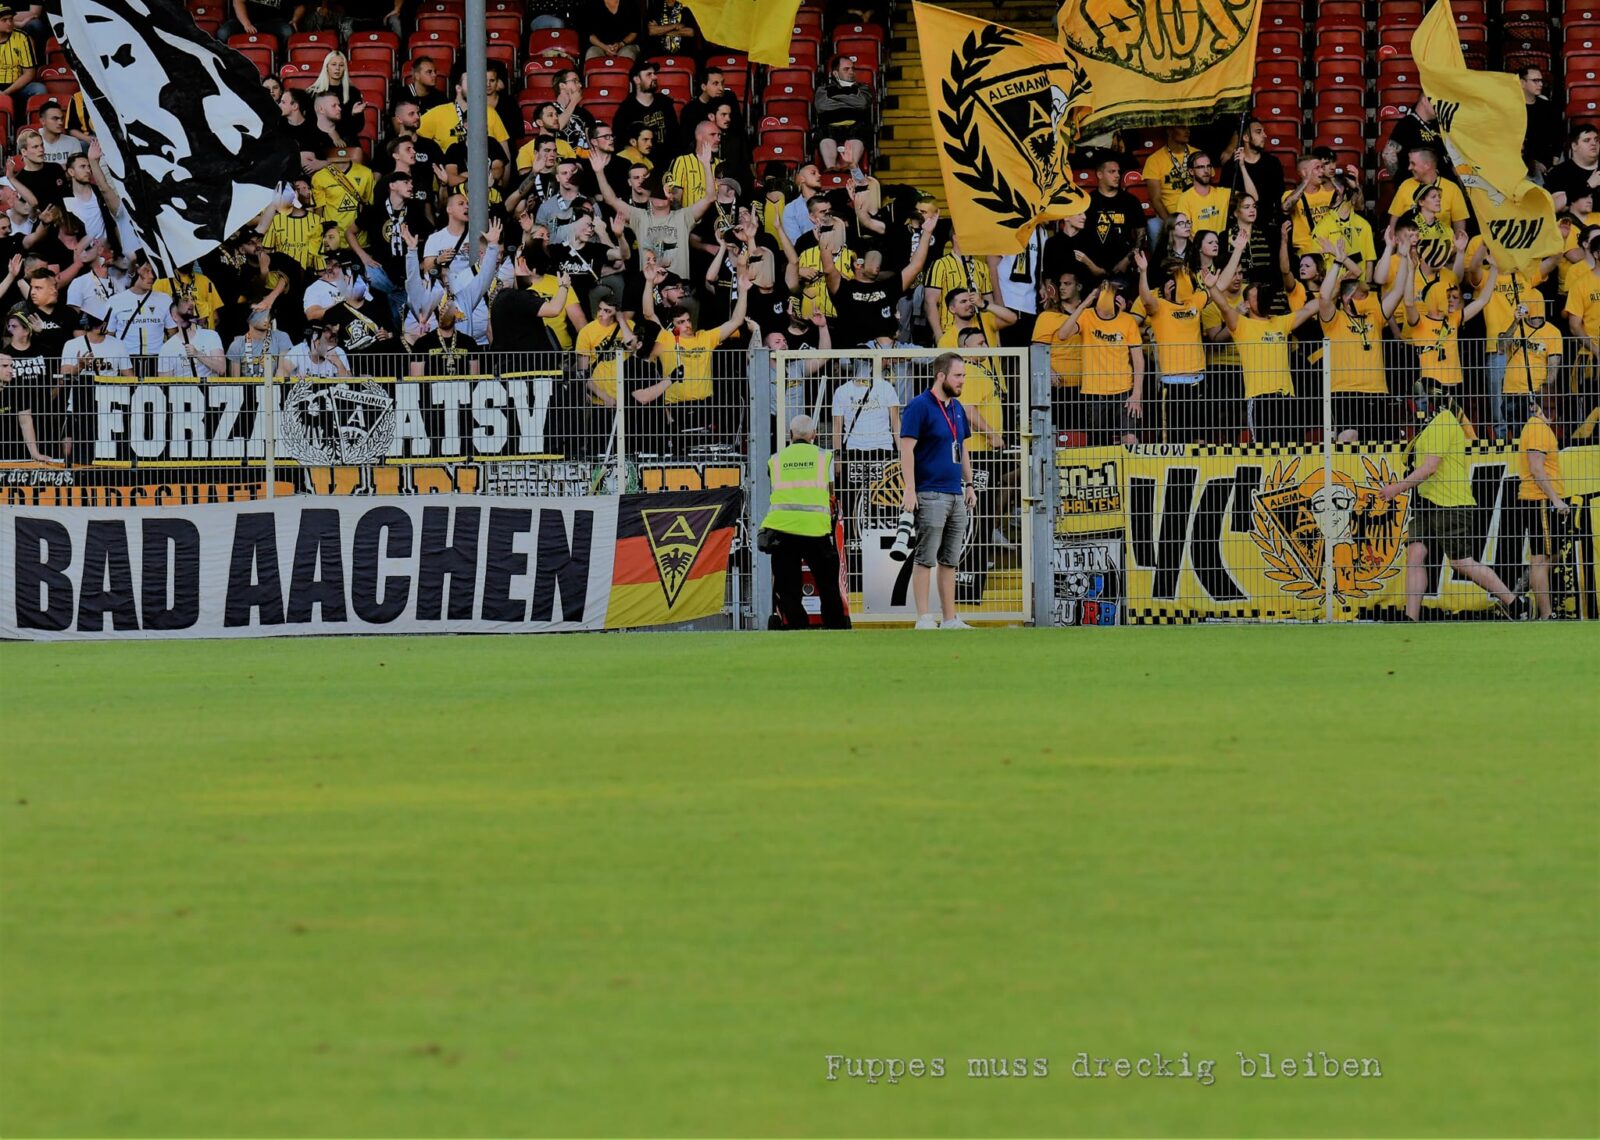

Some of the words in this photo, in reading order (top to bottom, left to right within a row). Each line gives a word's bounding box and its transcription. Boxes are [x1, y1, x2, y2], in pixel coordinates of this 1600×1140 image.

[333, 389, 387, 407] ALEMANNIA
[95, 385, 290, 459] FORZA
[385, 378, 553, 456] ATSV
[347, 404, 366, 428] A
[1125, 444, 1185, 456] YELLOW
[8, 469, 29, 483] die
[31, 469, 74, 486] Jungs,
[488, 461, 591, 480] LEGENDEN
[1077, 487, 1118, 500] REGEL
[661, 515, 696, 541] A
[15, 516, 200, 632] BAD
[224, 505, 594, 627] AACHEN
[1054, 548, 1108, 571] NEIN
[1082, 600, 1116, 625] RB
